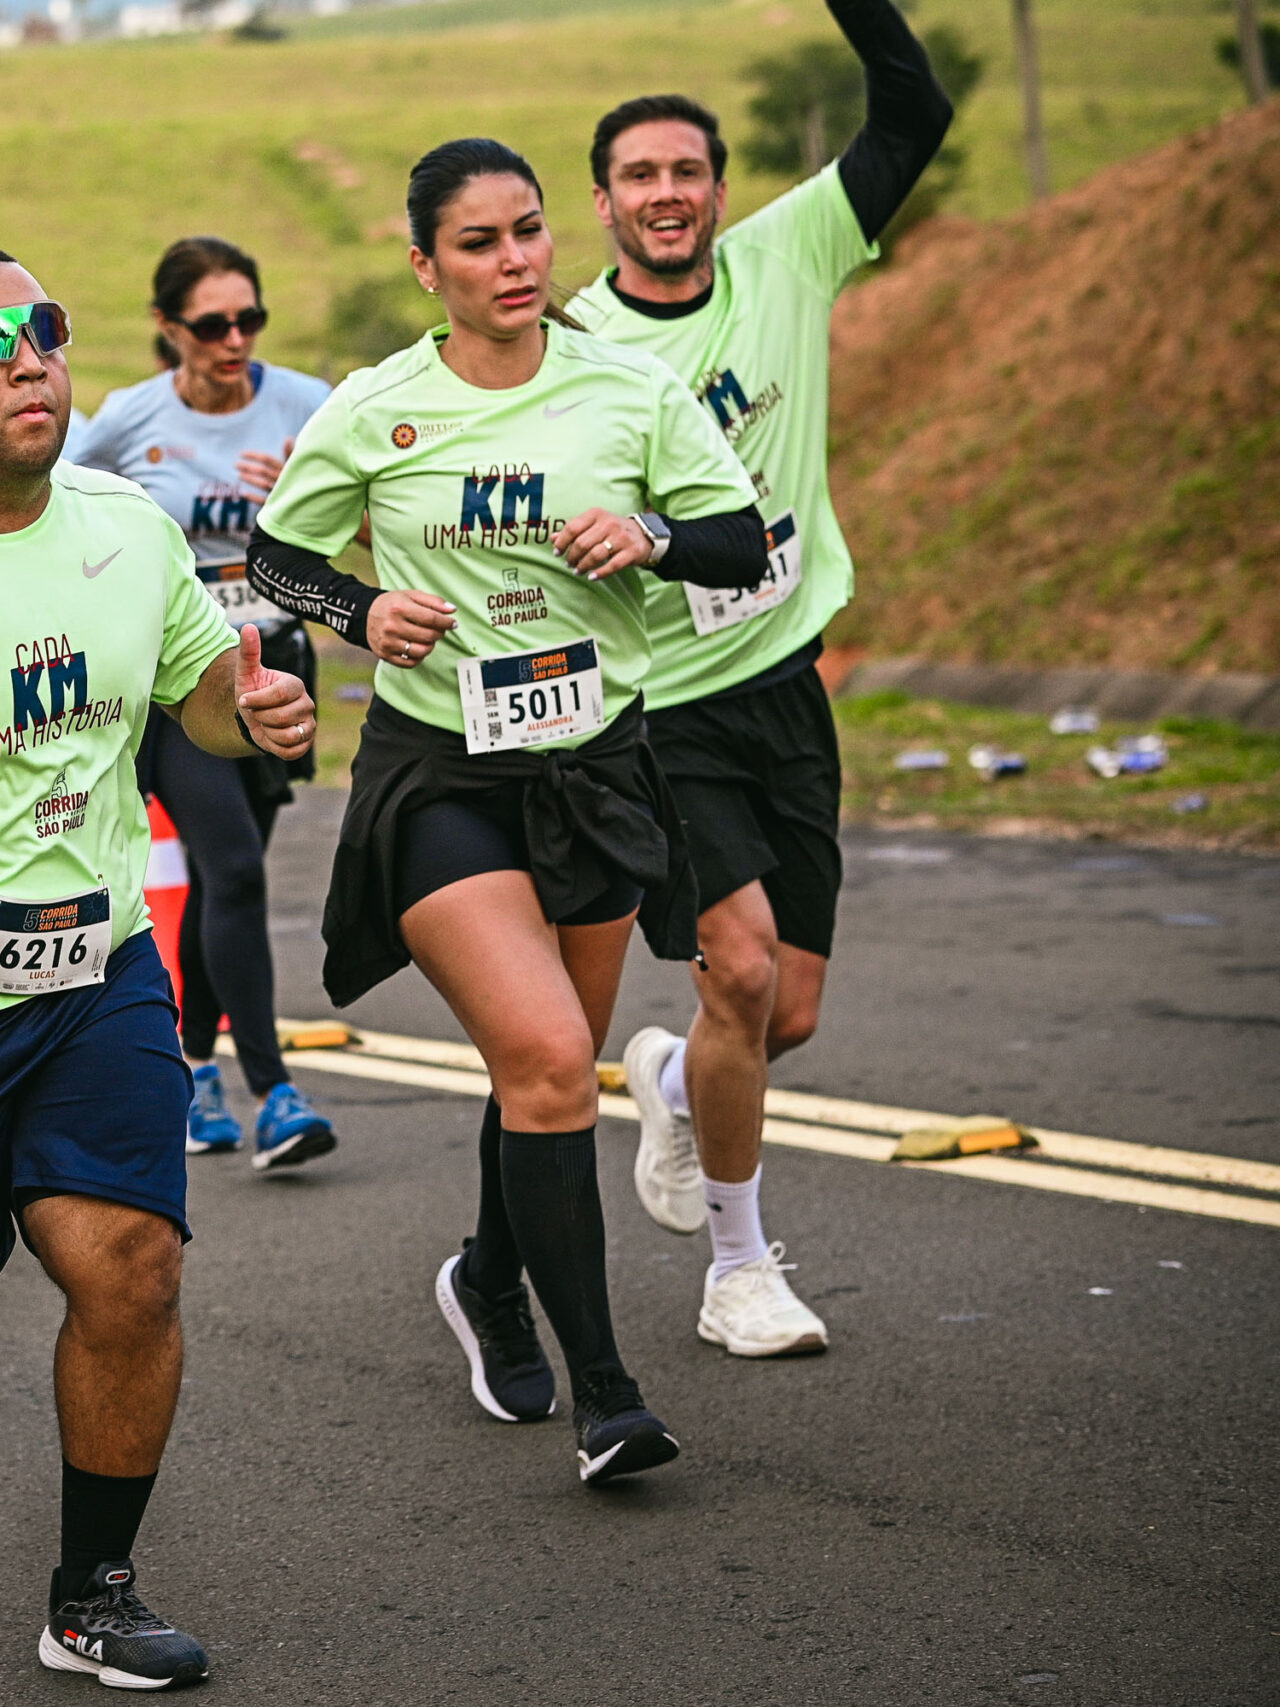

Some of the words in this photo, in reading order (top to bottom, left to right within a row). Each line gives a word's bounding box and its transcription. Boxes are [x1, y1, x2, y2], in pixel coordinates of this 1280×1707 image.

[460, 473, 545, 531] KM
[424, 524, 472, 550] UMA
[487, 586, 545, 610] CORRIDA
[514, 606, 548, 625] PAULO
[15, 633, 75, 675] CADA
[531, 652, 567, 670] CORRIDA
[10, 651, 88, 733] KM
[509, 680, 581, 725] 5011
[32, 696, 124, 749] HISTÓRIA
[527, 715, 574, 732] ALESSANDRA
[35, 790, 89, 819] CORRIDA
[62, 812, 86, 834] PAULO
[40, 903, 79, 920] CORRIDA
[53, 917, 77, 930] PAULO
[29, 969, 57, 980] LUCAS
[63, 1628, 103, 1662] FILA
